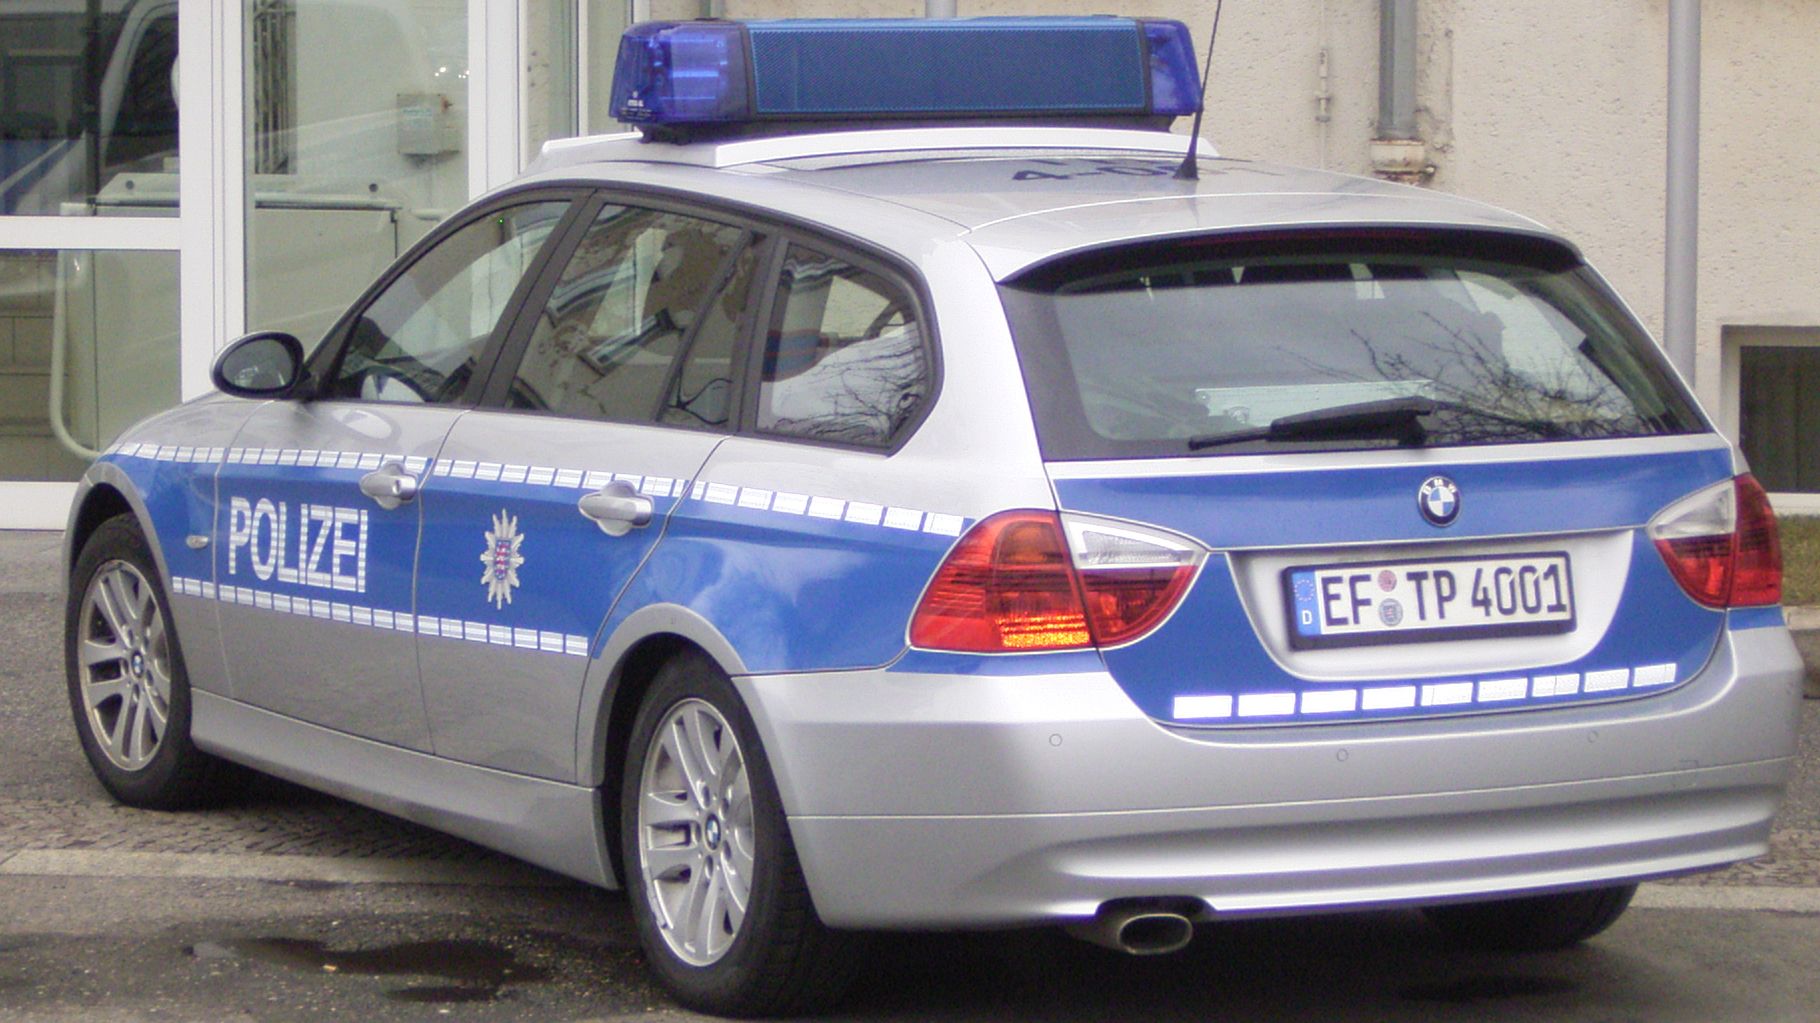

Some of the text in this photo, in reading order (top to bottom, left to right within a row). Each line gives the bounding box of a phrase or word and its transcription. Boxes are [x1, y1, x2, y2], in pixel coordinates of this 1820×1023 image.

[229, 497, 368, 593] POLIZEI
[1302, 564, 1568, 627] D EF TP 4001
